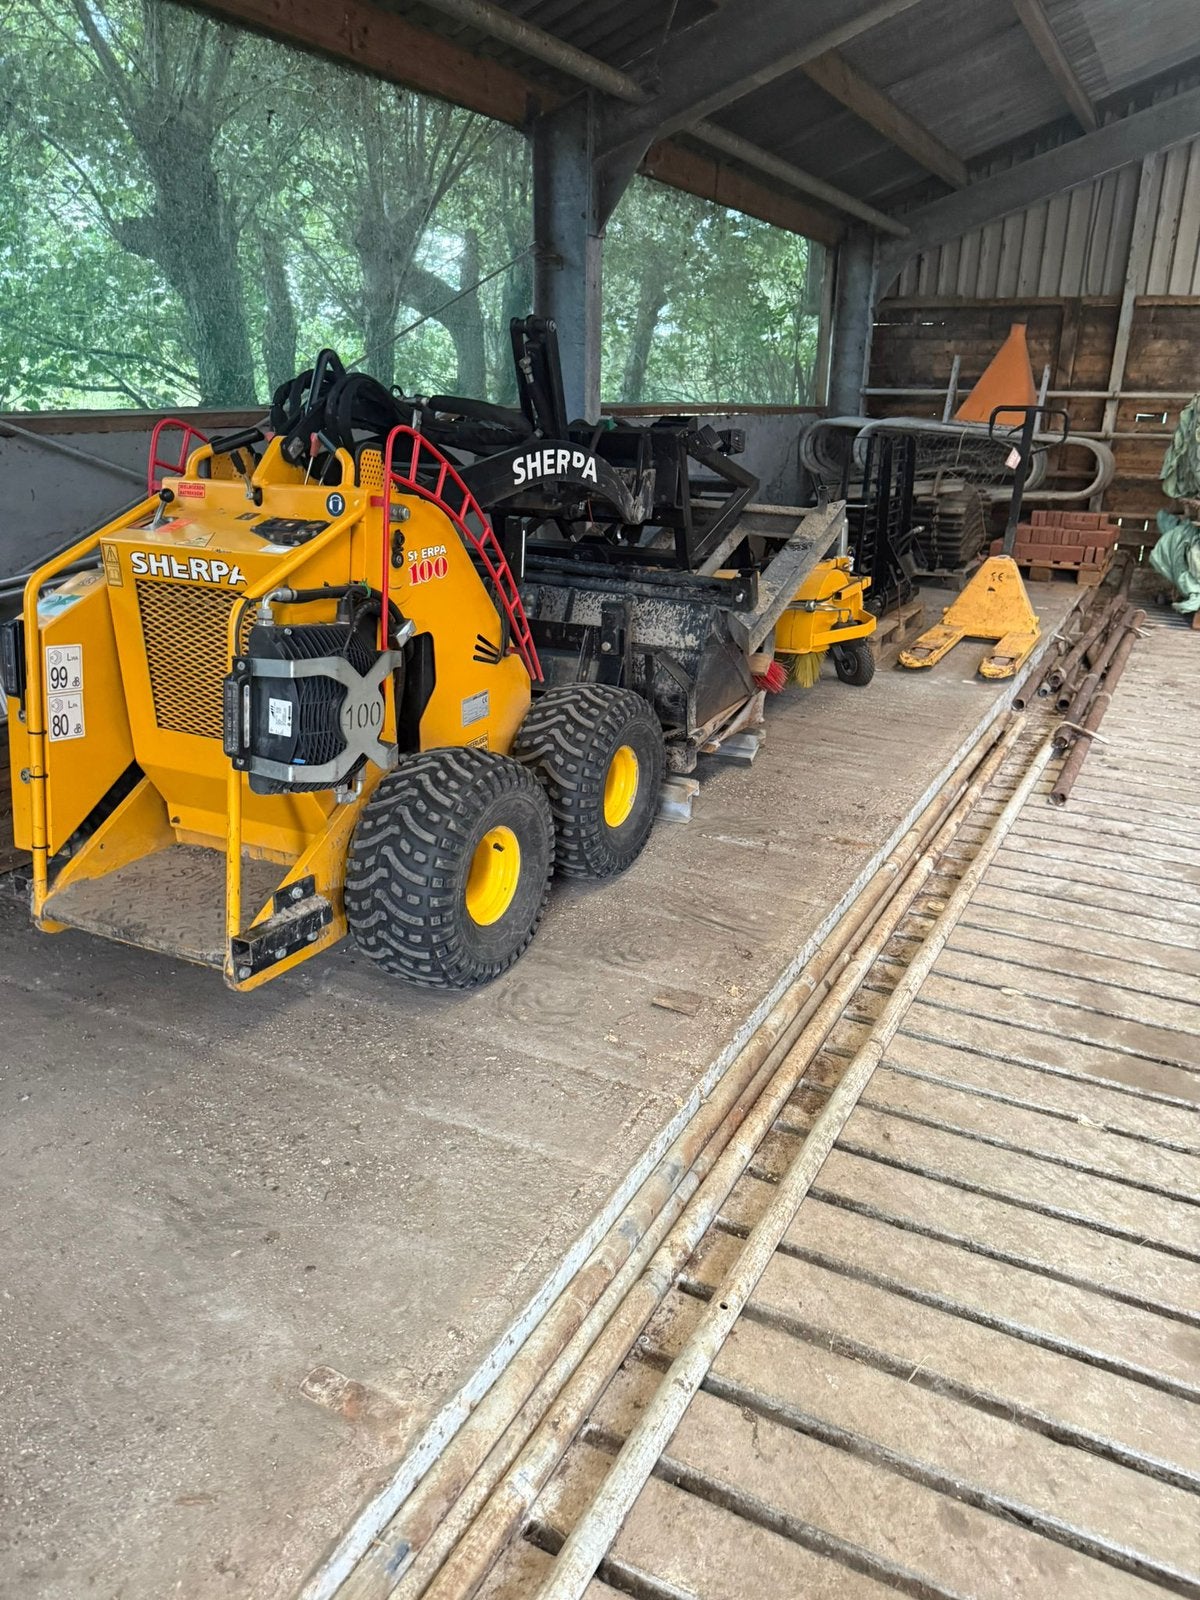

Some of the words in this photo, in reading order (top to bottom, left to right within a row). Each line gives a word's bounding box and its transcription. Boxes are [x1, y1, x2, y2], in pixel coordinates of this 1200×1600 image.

[512, 449, 598, 485] SHERPA
[408, 555, 449, 586] 100
[51, 666, 68, 689] 99
[72, 676, 80, 687] dB
[52, 713, 69, 737] 80
[74, 723, 82, 734] dB
[346, 701, 381, 730] 100
